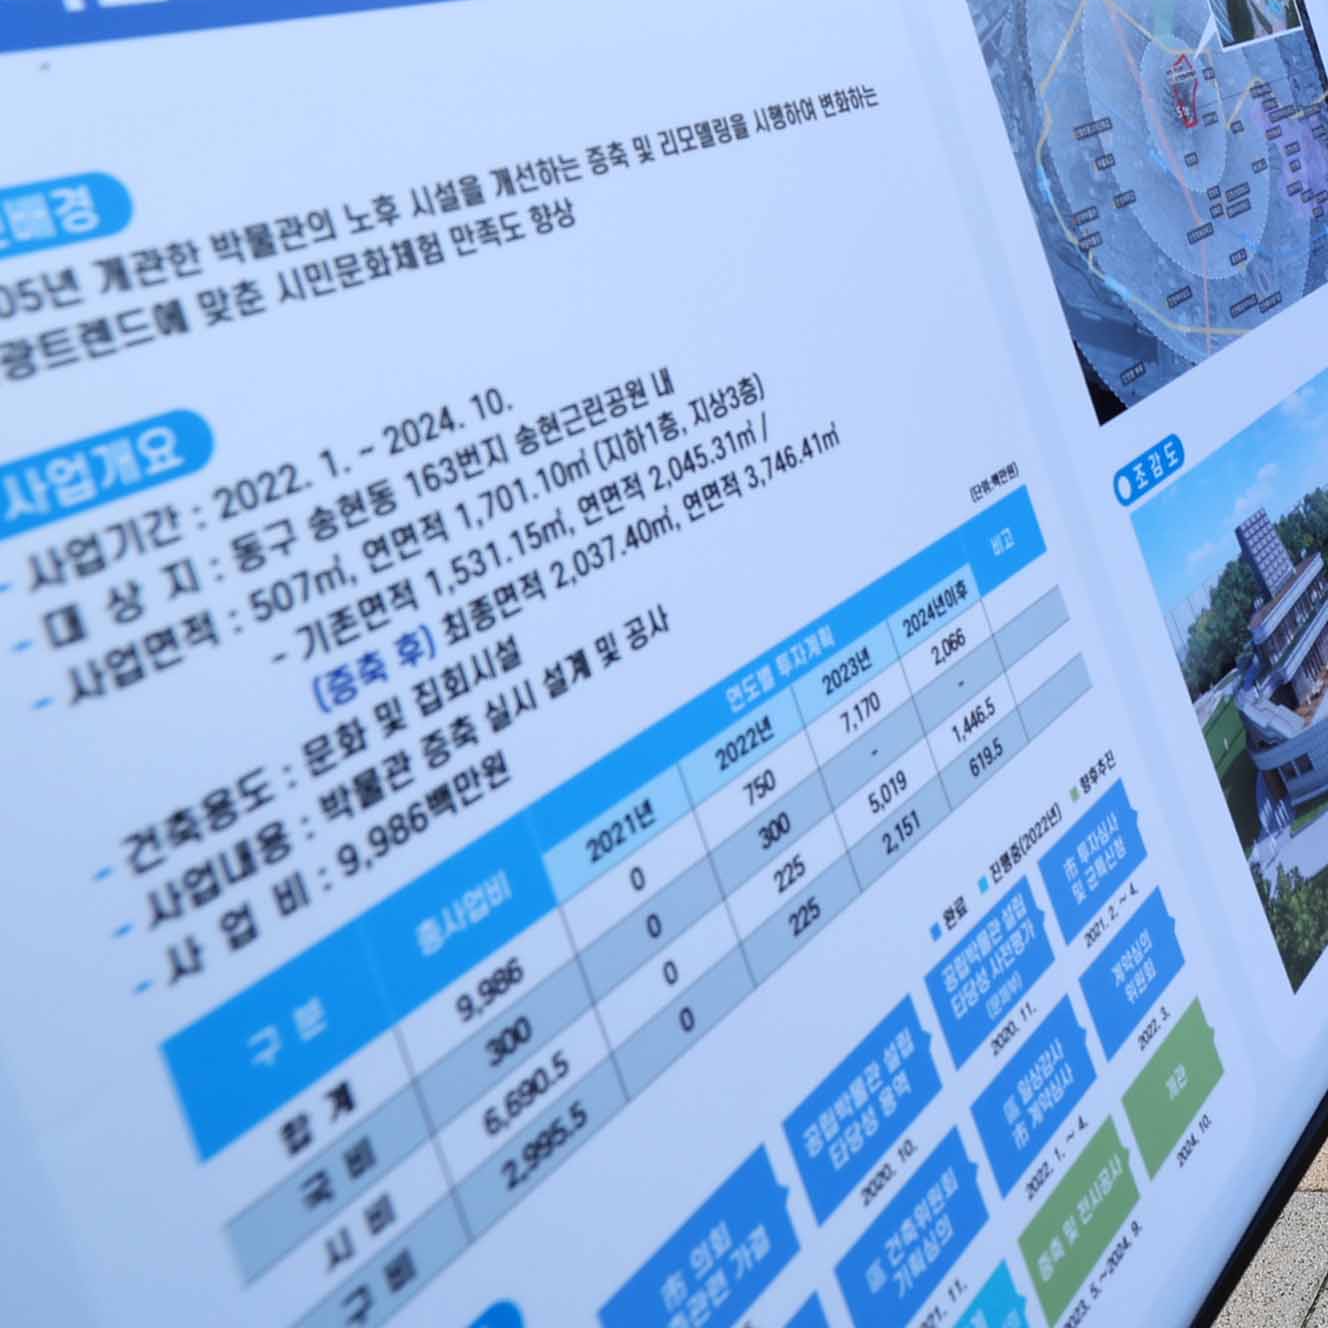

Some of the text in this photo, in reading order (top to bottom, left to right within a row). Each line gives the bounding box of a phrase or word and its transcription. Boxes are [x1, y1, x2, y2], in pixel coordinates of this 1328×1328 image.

[92, 239, 205, 295] 개관한
[209, 208, 338, 264] 박물관의
[344, 192, 401, 234] 노후
[410, 172, 486, 219] 시설을
[488, 153, 583, 198] 개선하는
[585, 141, 630, 175] 증축
[631, 134, 656, 165] 및
[656, 112, 750, 157] 리모델링을
[753, 97, 818, 135] 시행하여
[818, 84, 880, 120] 변화하는
[197, 280, 267, 327] 맞춘
[277, 232, 446, 304] 시민문화체험
[449, 211, 527, 260] 만족도
[528, 197, 577, 235] 향상
[2, 424, 187, 522] 사업개요
[26, 386, 514, 594] 사업기간 2022. 1. 2024. 10.
[229, 366, 676, 574] 동구 송현동 163번지 송현근린공원 내
[67, 609, 220, 706] 사업면적
[361, 510, 450, 575] 연면적
[593, 408, 689, 472] (지하1층,
[687, 372, 767, 427] 지상3층)
[296, 575, 420, 660] 기존면적
[576, 473, 648, 526] 연면적
[990, 527, 1016, 558] 비고
[311, 649, 390, 714] (증축
[393, 622, 438, 670] 후)
[440, 569, 548, 648] 최종면적
[682, 469, 744, 523] 연면적
[901, 577, 970, 640] 2024년이후
[724, 624, 836, 714] 연도별 투자계획
[821, 646, 874, 697] 2023년
[930, 626, 967, 668] 2,066
[839, 689, 882, 736] 7,170
[951, 695, 997, 745] 1,446.5
[121, 634, 523, 879] 건축용도 문화 및 집회시설
[146, 602, 672, 932] 사업내용 박물관 증축 실시 설계 및 공사
[714, 714, 776, 773] 2022년
[968, 736, 1005, 779] 619.5
[335, 750, 514, 879] 9,986백만원
[742, 768, 777, 806] 750
[868, 769, 909, 815] 5,019
[584, 798, 656, 866] 2021년
[758, 811, 793, 851] 300
[881, 808, 922, 857] 2,151
[630, 865, 646, 891] 0
[773, 854, 807, 894] 225
[645, 913, 662, 939] 0
[788, 897, 822, 937] 225
[942, 895, 970, 931] 완료
[454, 955, 527, 1023] 9,986
[663, 959, 678, 986] 0
[484, 1016, 534, 1069] 300
[679, 1006, 695, 1034] 0
[481, 1050, 572, 1137] 6,690.5
[500, 1101, 590, 1191] 2,995.5
